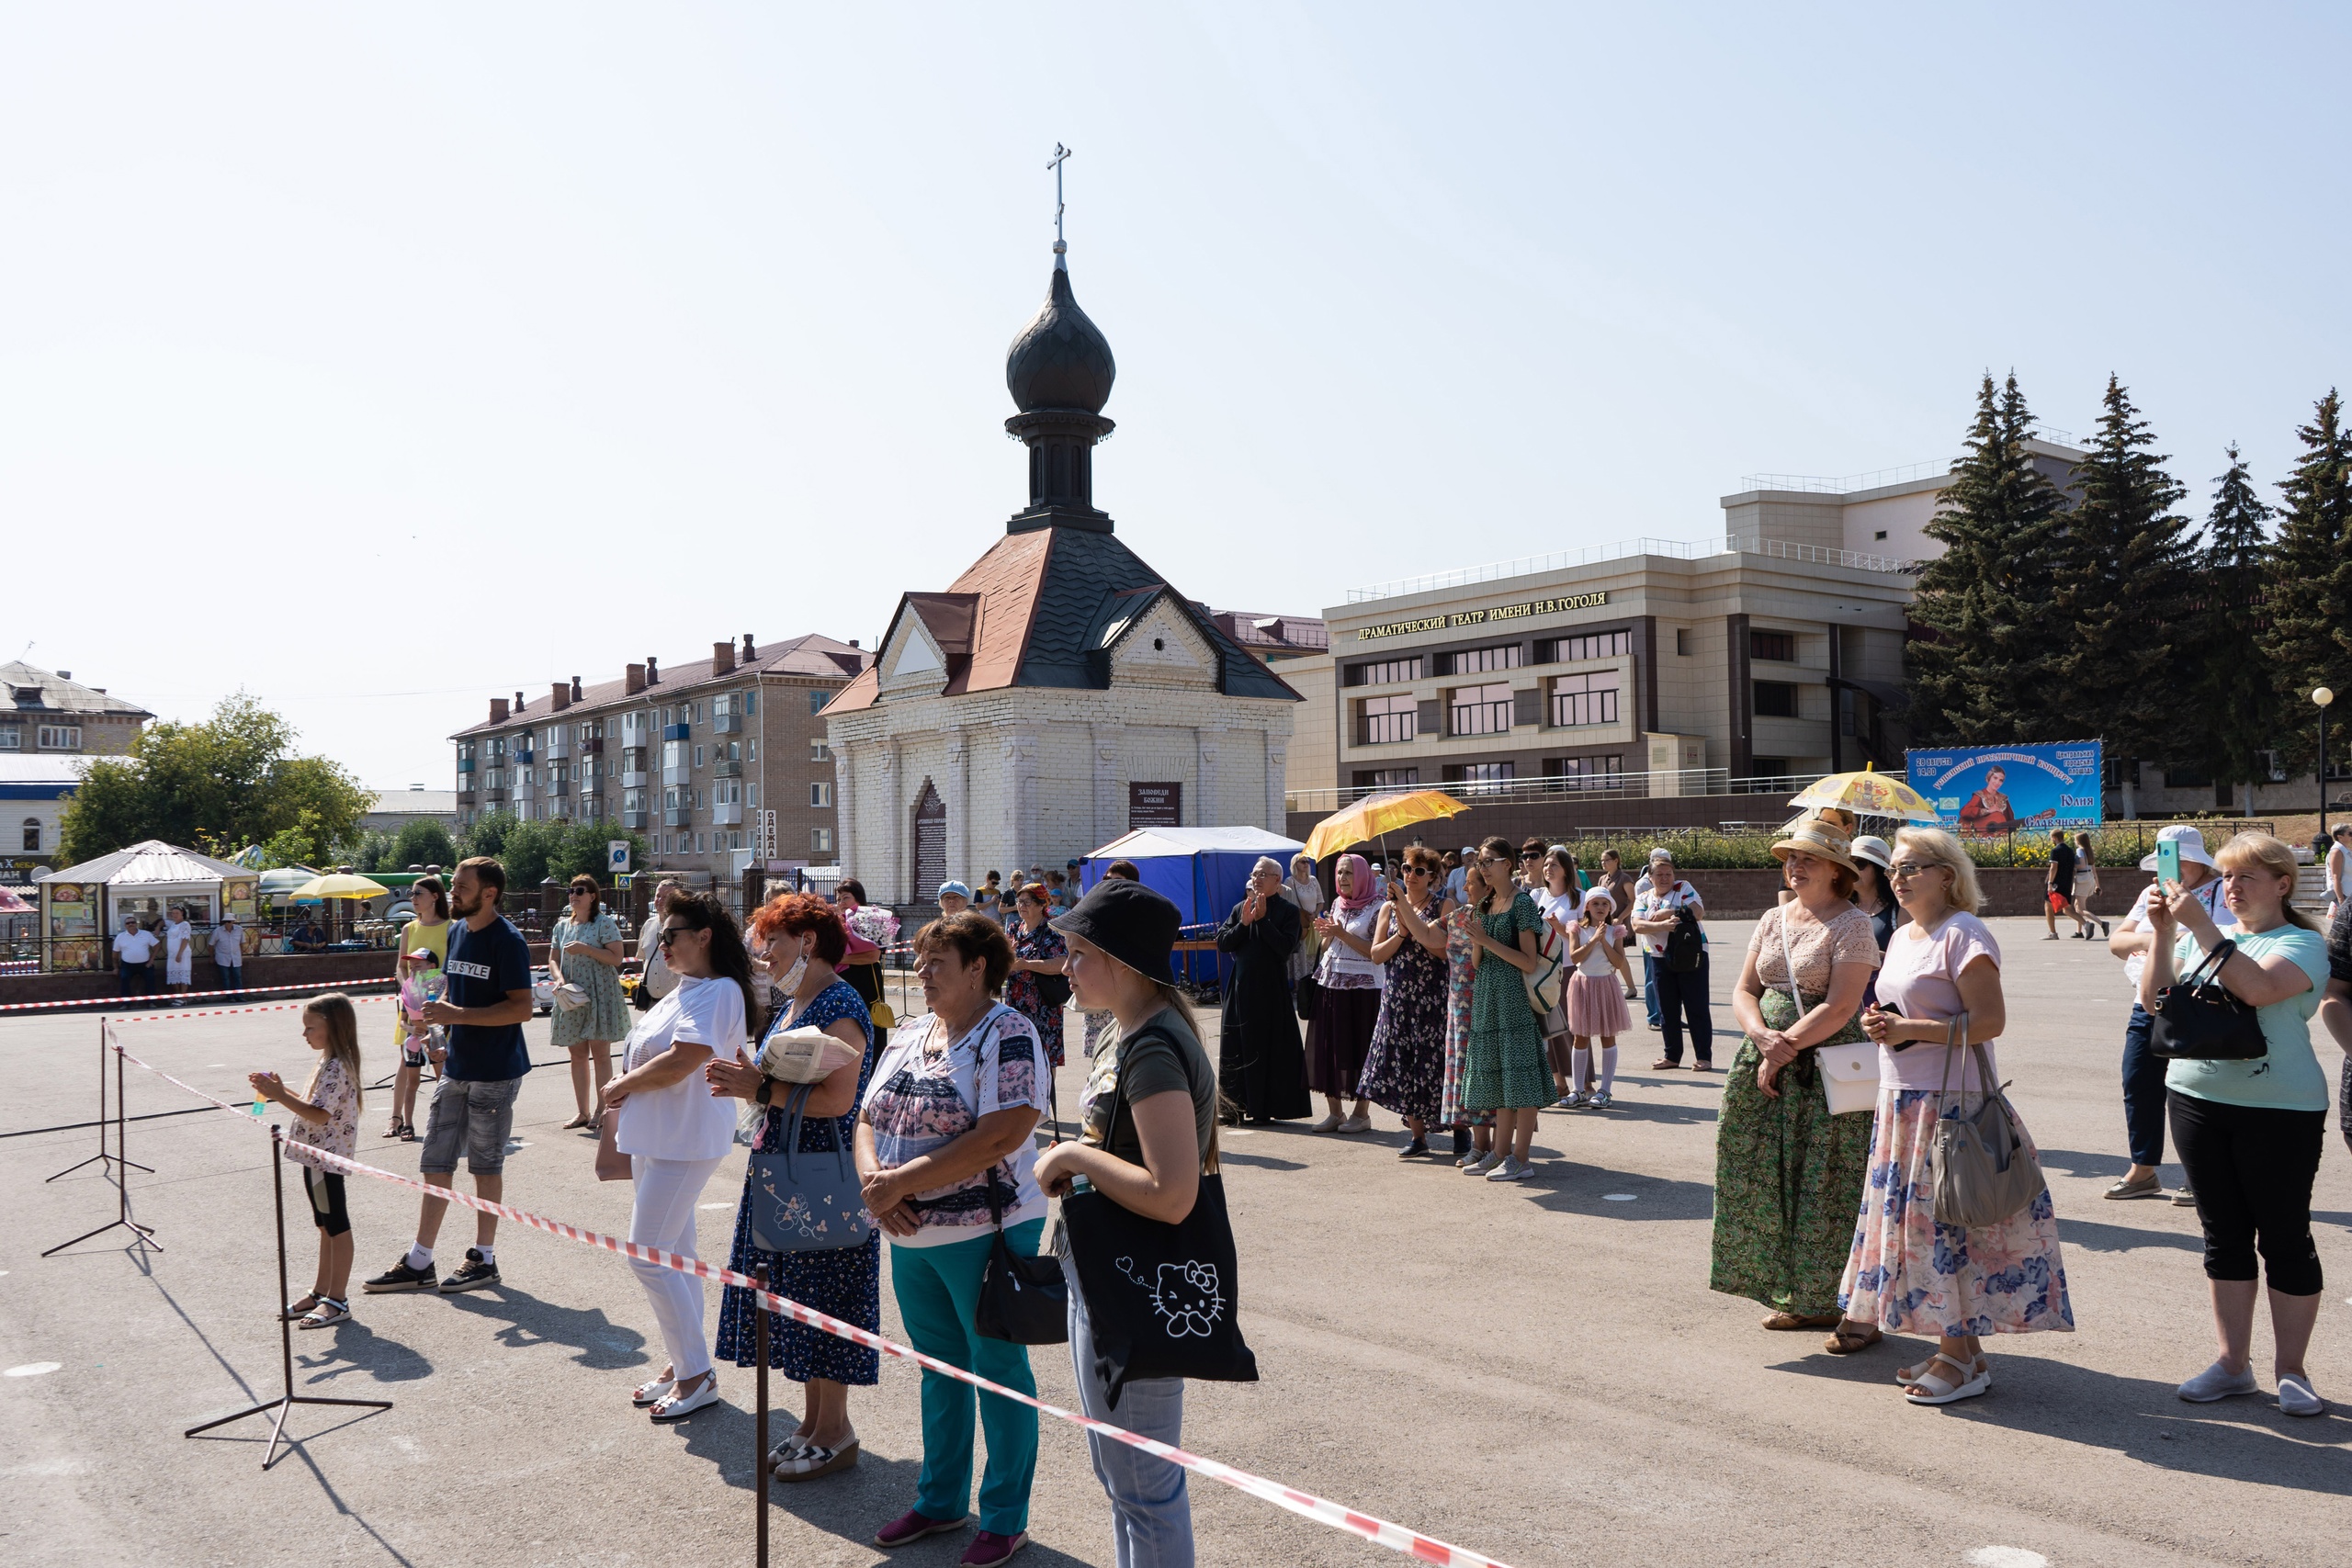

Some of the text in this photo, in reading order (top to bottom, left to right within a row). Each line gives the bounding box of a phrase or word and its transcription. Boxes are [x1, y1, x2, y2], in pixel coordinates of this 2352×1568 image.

[1358, 615, 1446, 640] ДРАМАТИЧЕСКИЙ
[1452, 611, 1485, 626] ТЕАТР
[1489, 604, 1532, 621] ИМЕНИ
[1558, 592, 1606, 611] ГОГОЛЯ
[2056, 750, 2094, 760] Центральная
[1917, 758, 1952, 766] 28 августа
[2064, 759, 2094, 767] городская
[1917, 768, 1937, 776] 14.00
[1933, 752, 2074, 790] УСПЕНСКИЙ ПРАЗДНИЧНЫЙ КОНЦЕРТ
[2068, 767, 2094, 775] площадь
[2061, 794, 2094, 807] Юлия
[766, 811, 775, 857] ОДЕЖДА
[448, 962, 488, 977] EW STYLE
